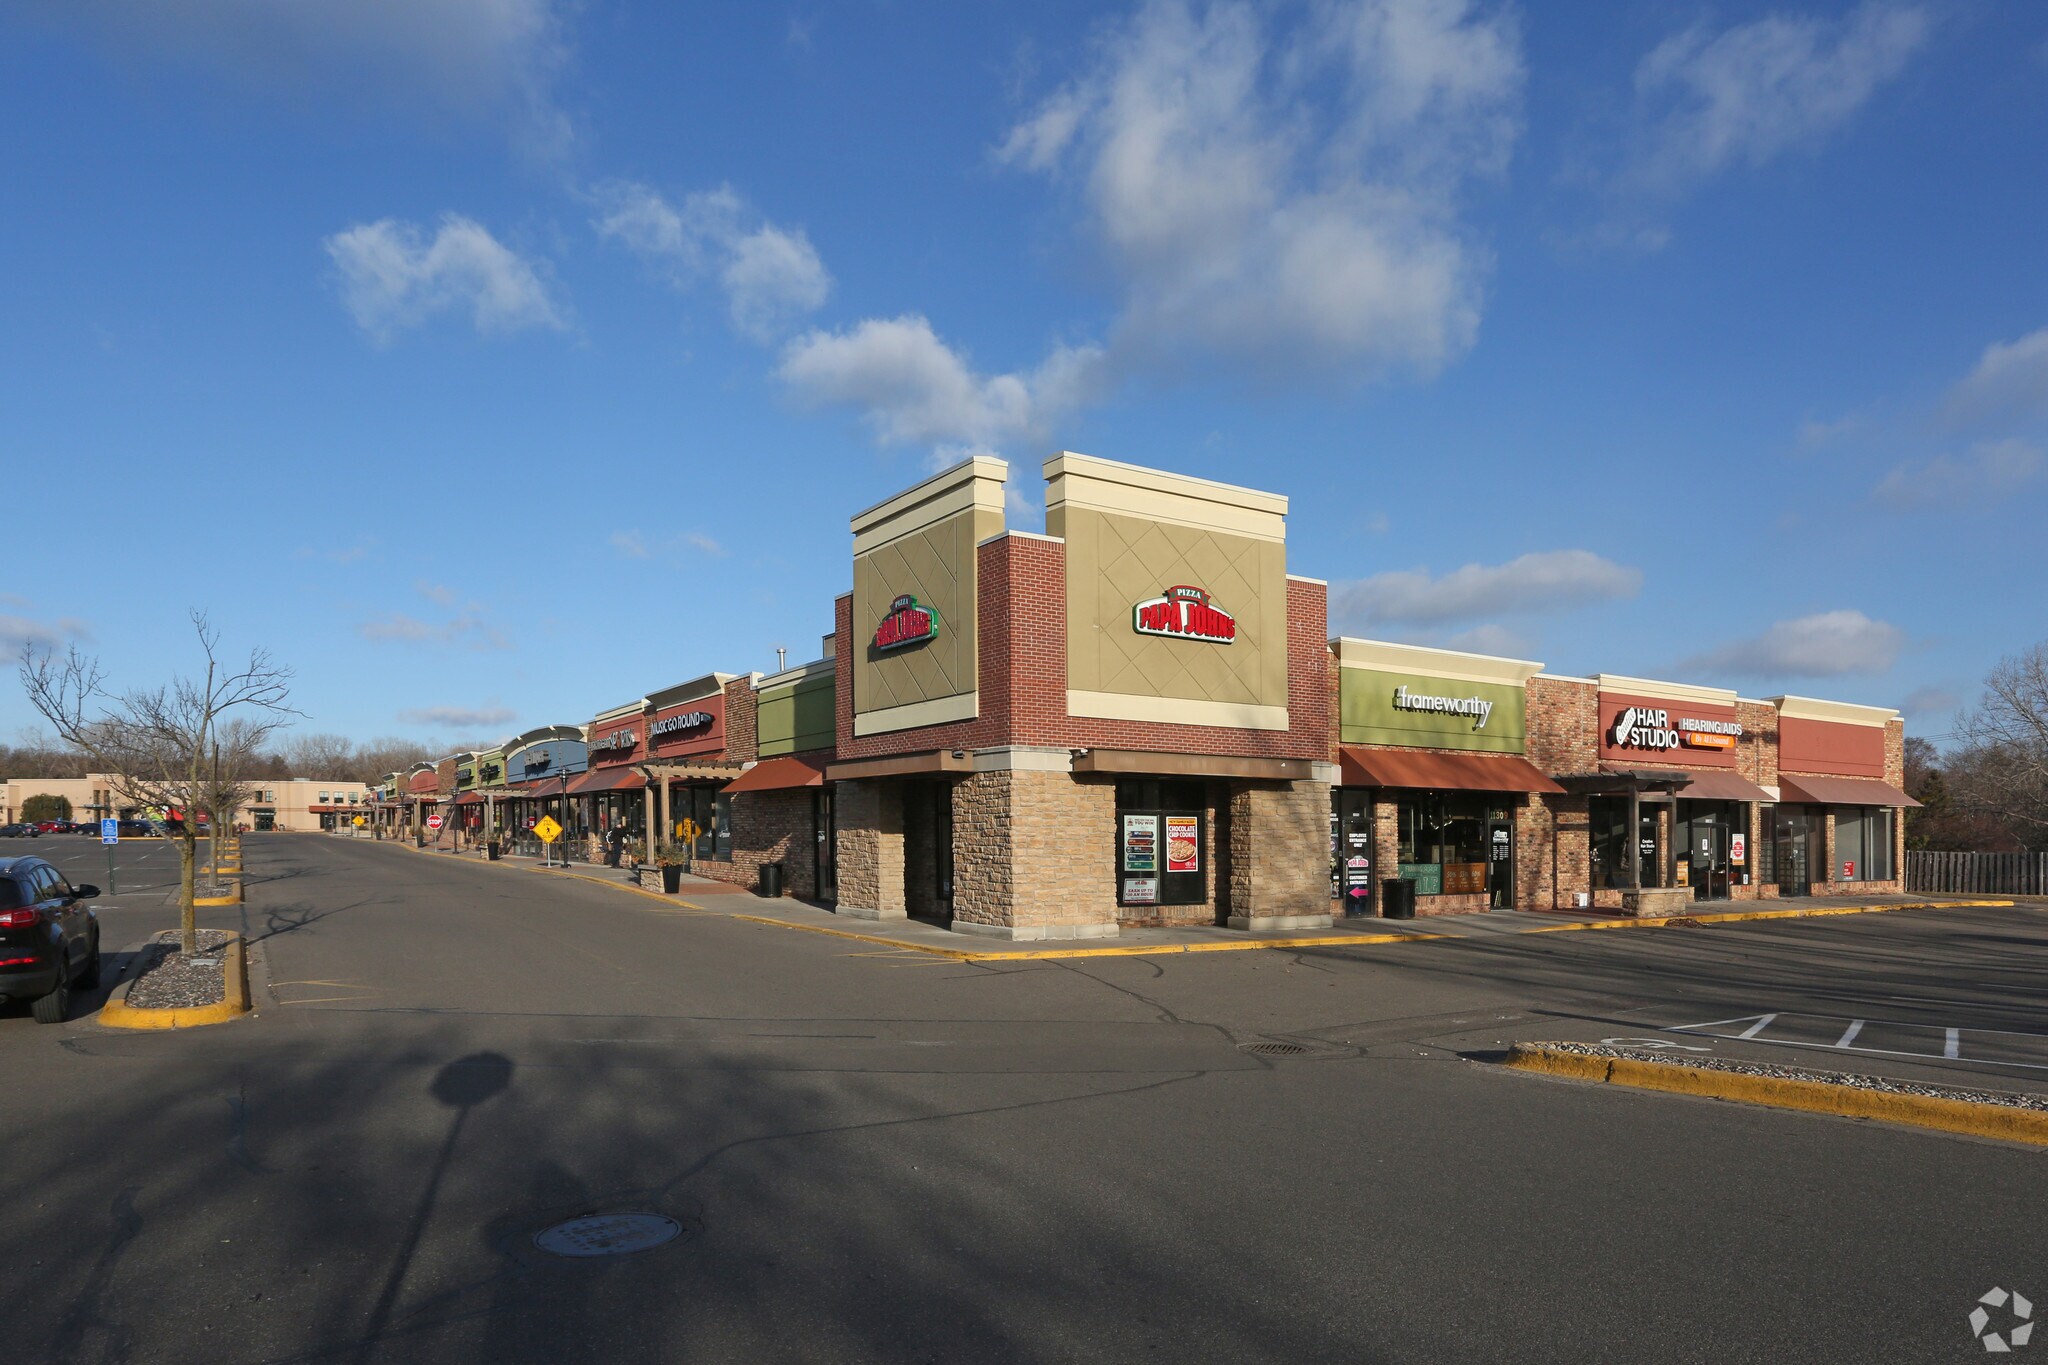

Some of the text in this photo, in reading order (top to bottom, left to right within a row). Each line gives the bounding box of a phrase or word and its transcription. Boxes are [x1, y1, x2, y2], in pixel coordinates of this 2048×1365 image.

[1176, 588, 1201, 599] PIZZA
[1139, 602, 1235, 639] PAPA JOHNS
[1398, 685, 1493, 728] frameworthy
[651, 711, 700, 735] MUSIC GO ROUND
[1637, 708, 1668, 728] HAIR
[1682, 718, 1743, 736] HEARING AIDS
[1631, 727, 1679, 749] STUDIO
[428, 818, 442, 826] STOP
[1490, 809, 1508, 819] 11309
